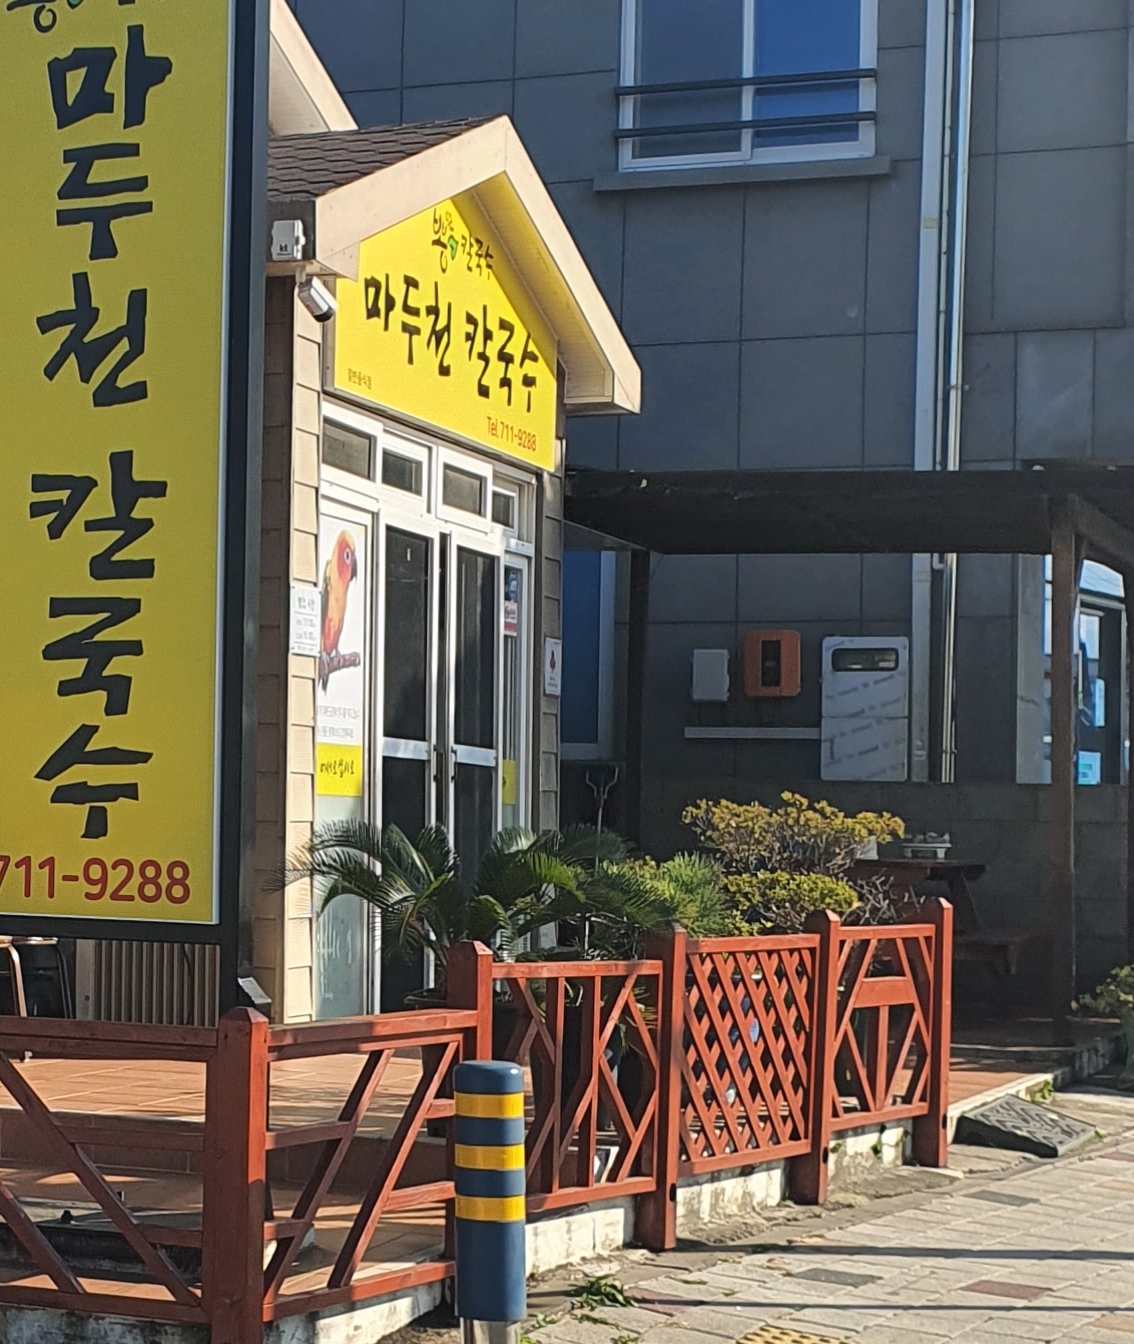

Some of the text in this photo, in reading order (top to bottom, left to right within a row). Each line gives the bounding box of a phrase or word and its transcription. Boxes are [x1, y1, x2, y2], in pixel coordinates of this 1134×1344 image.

[460, 231, 494, 281] 칼국수
[364, 273, 539, 414] 마두천 칼국수
[28, 24, 173, 839] 마두천 칼국수
